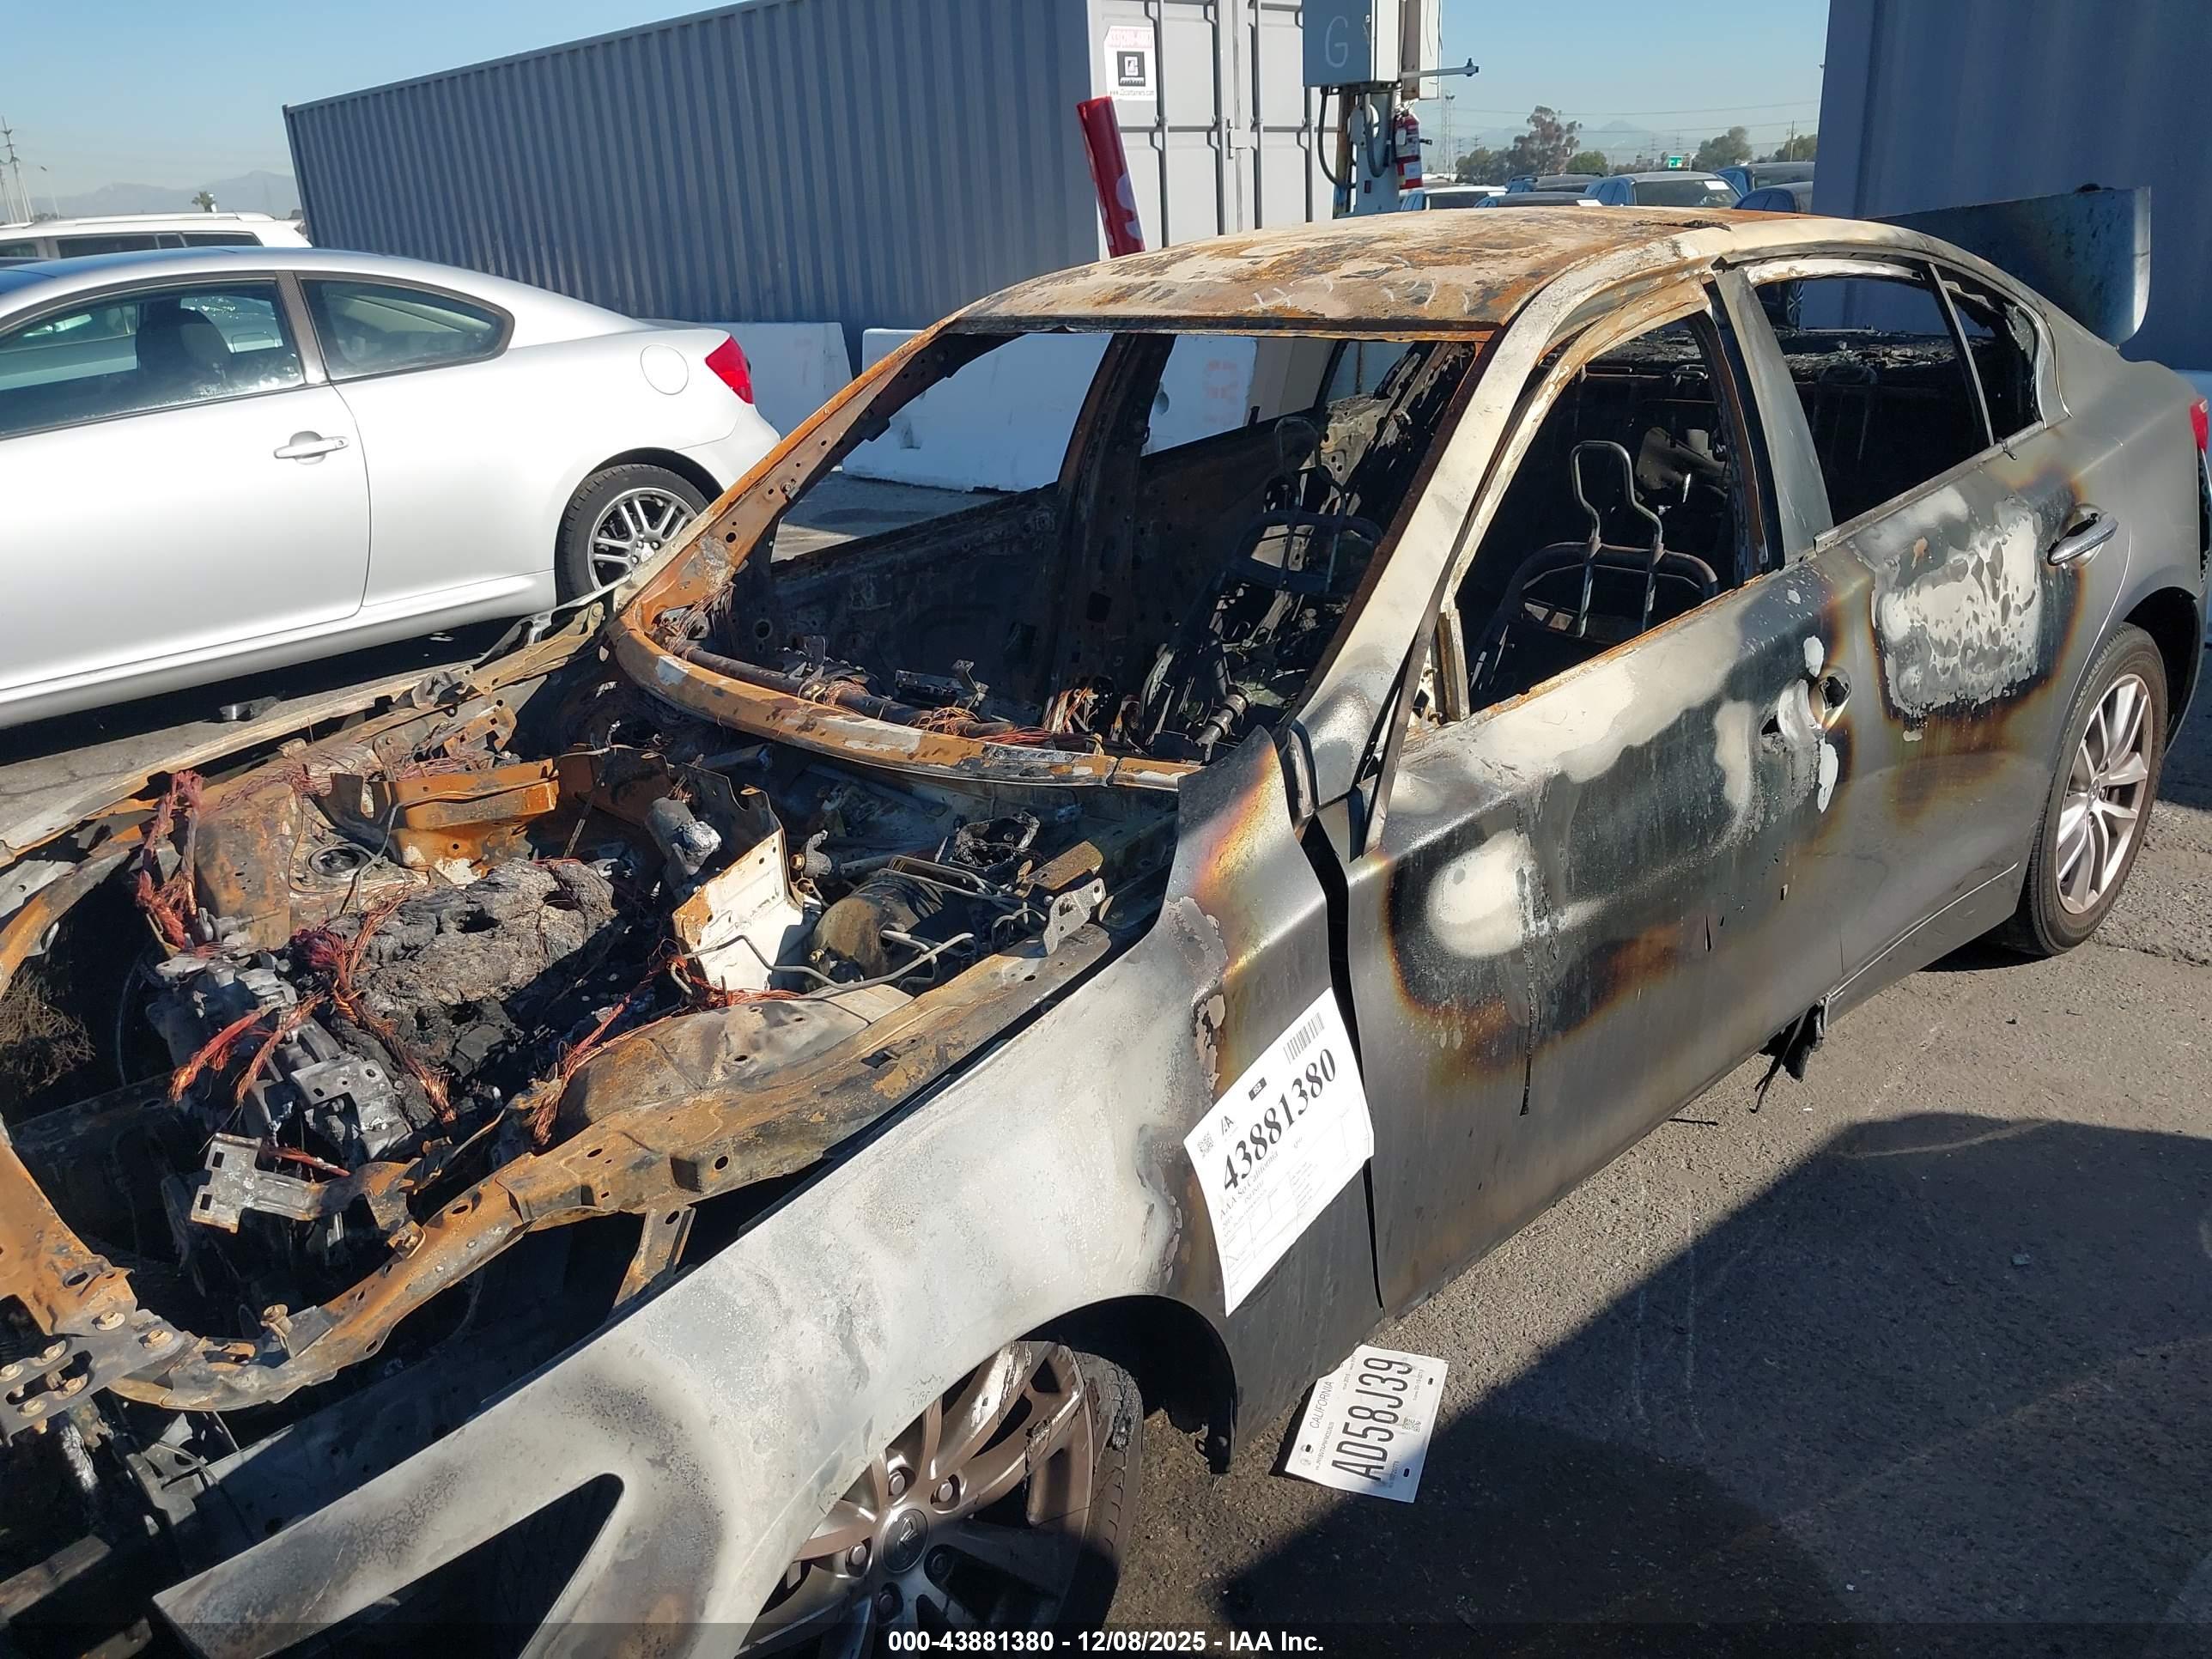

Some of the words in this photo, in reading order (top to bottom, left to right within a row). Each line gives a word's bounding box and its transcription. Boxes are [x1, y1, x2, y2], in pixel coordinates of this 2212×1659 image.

[1325, 15, 1348, 68] G
[1224, 1048, 1336, 1190] 43881380
[1310, 1381, 1334, 1429] CALIFORNIA
[1331, 1357, 1413, 1481] AD58J39
